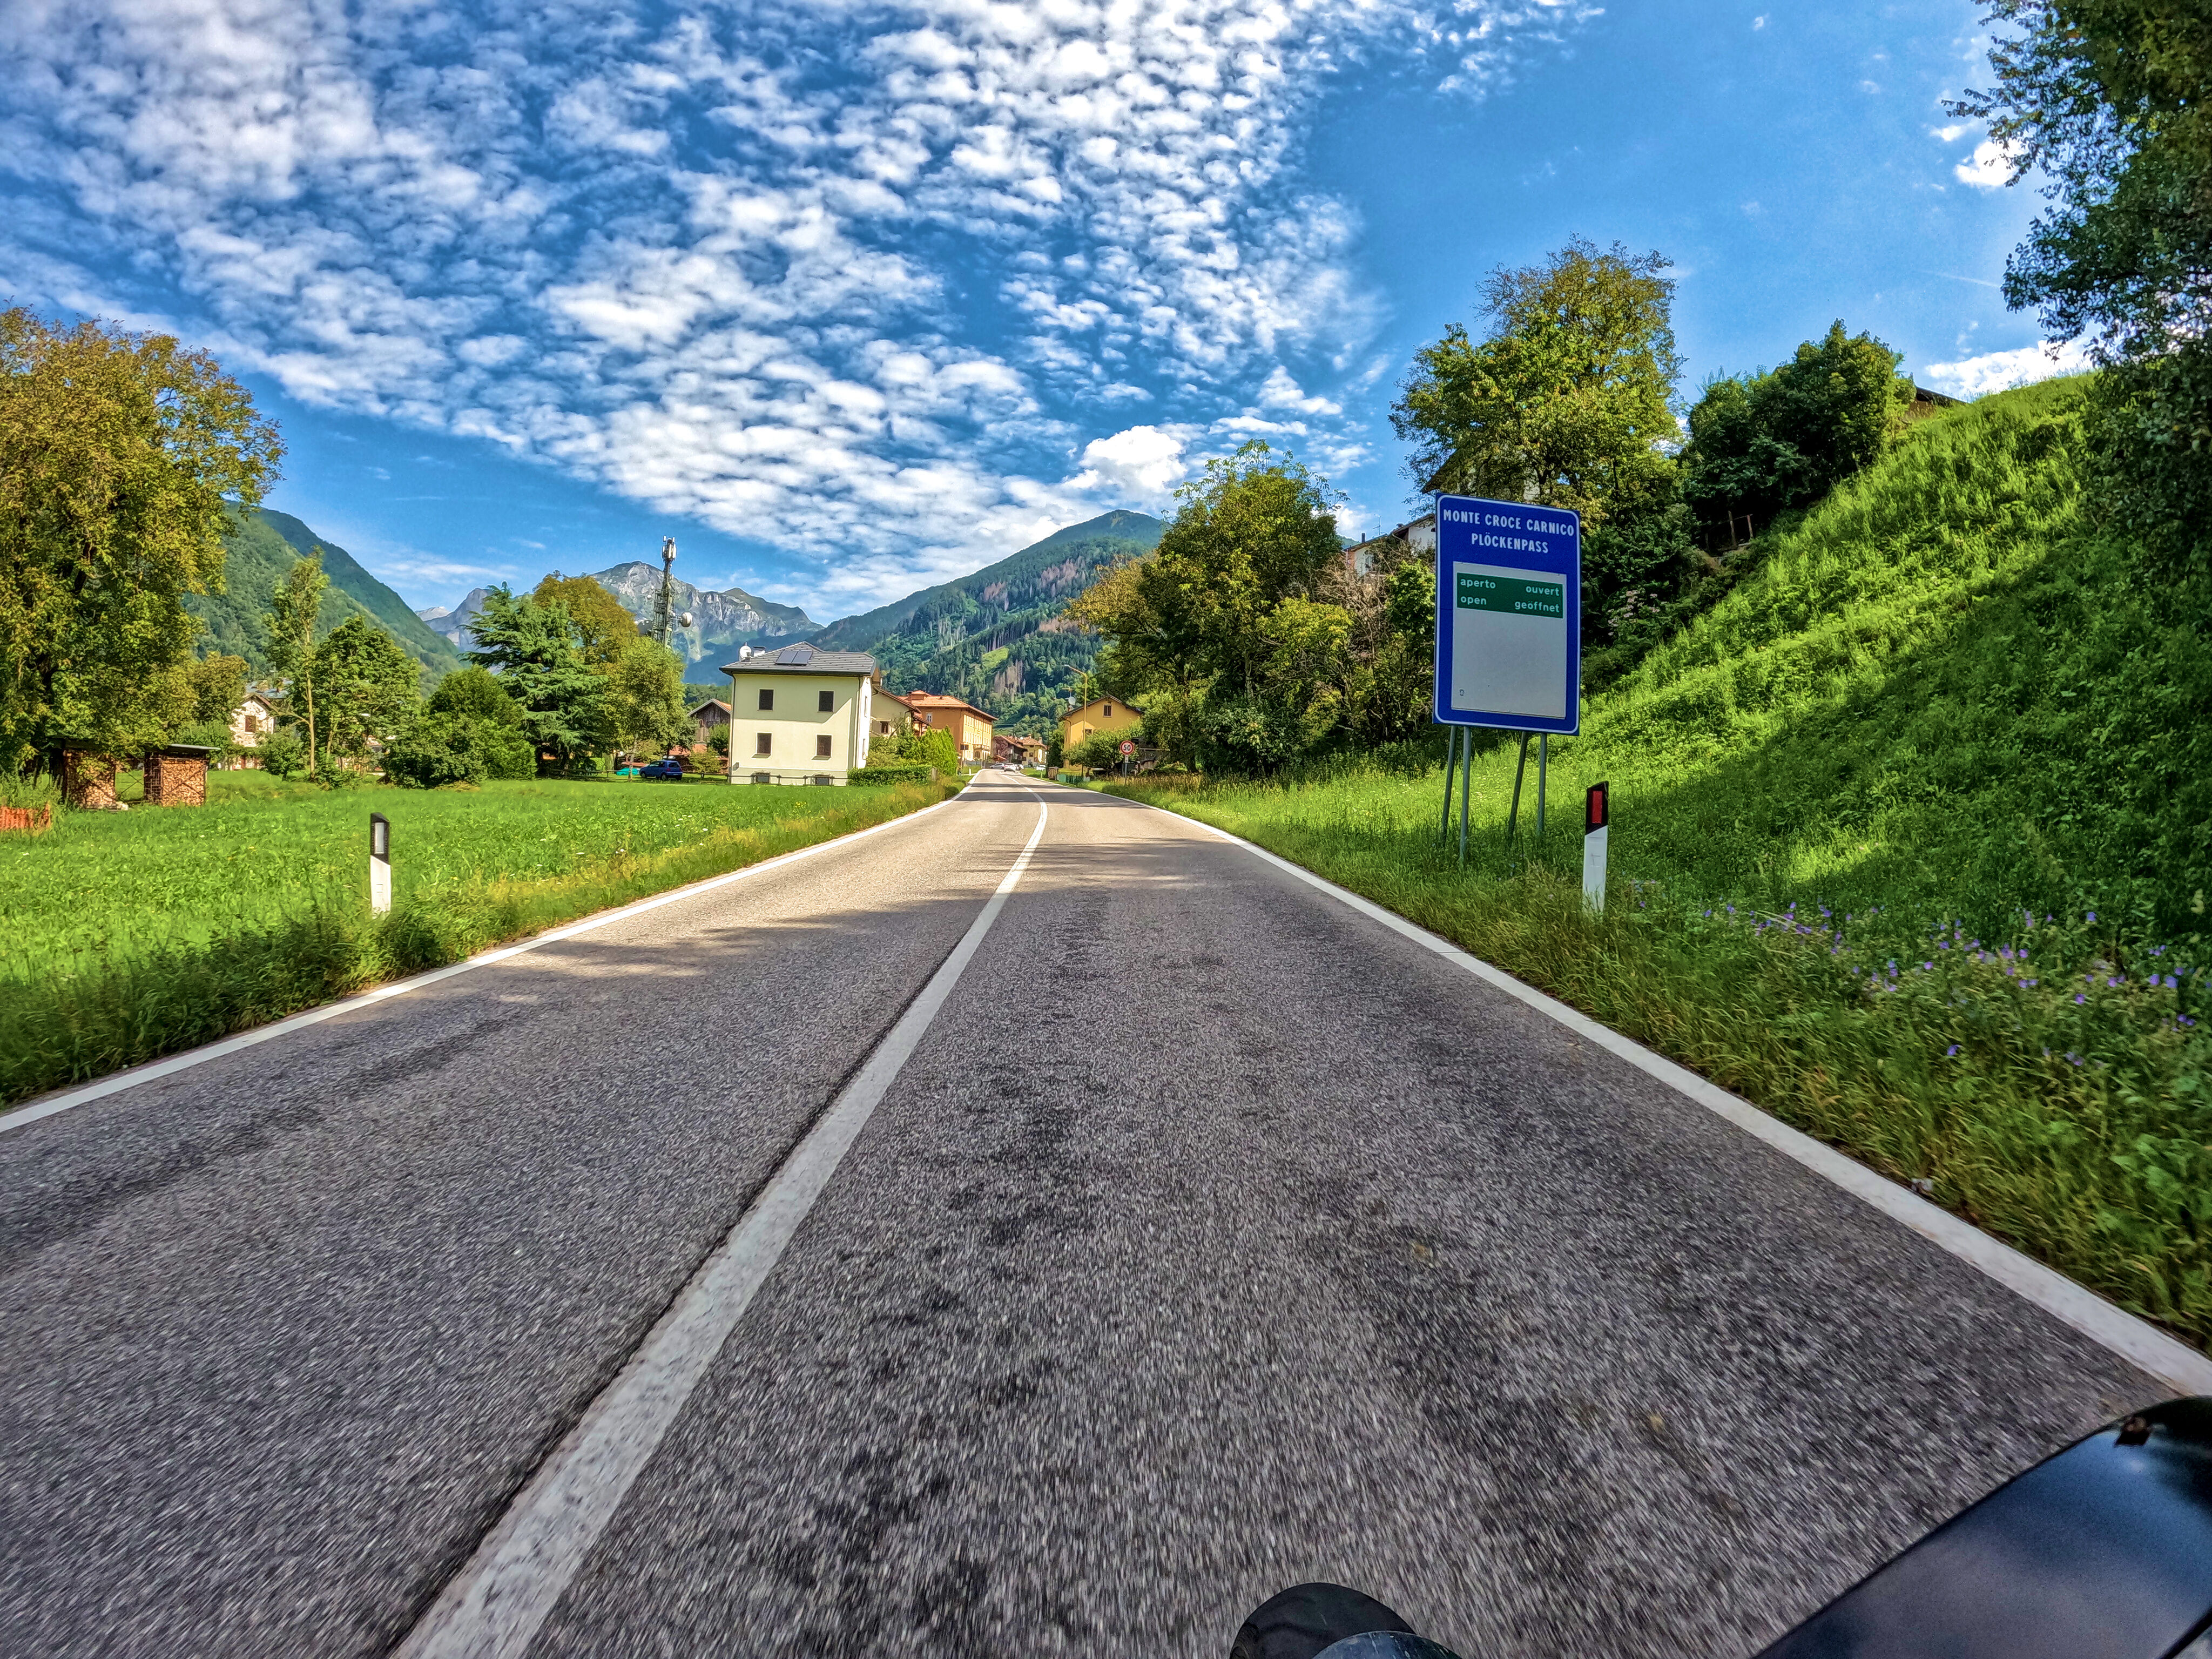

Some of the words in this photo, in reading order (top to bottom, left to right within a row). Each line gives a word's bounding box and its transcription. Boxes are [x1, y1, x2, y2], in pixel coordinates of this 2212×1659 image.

[1444, 509, 1480, 524] MONTE
[1485, 514, 1521, 529] CROCE
[1526, 519, 1574, 536] CARNICO
[1471, 532, 1548, 553] PLÖCKENPASS
[1460, 578, 1496, 589] aperto
[1526, 585, 1559, 596] ouvert
[1460, 596, 1487, 605] open
[1514, 601, 1560, 613] geöffnet
